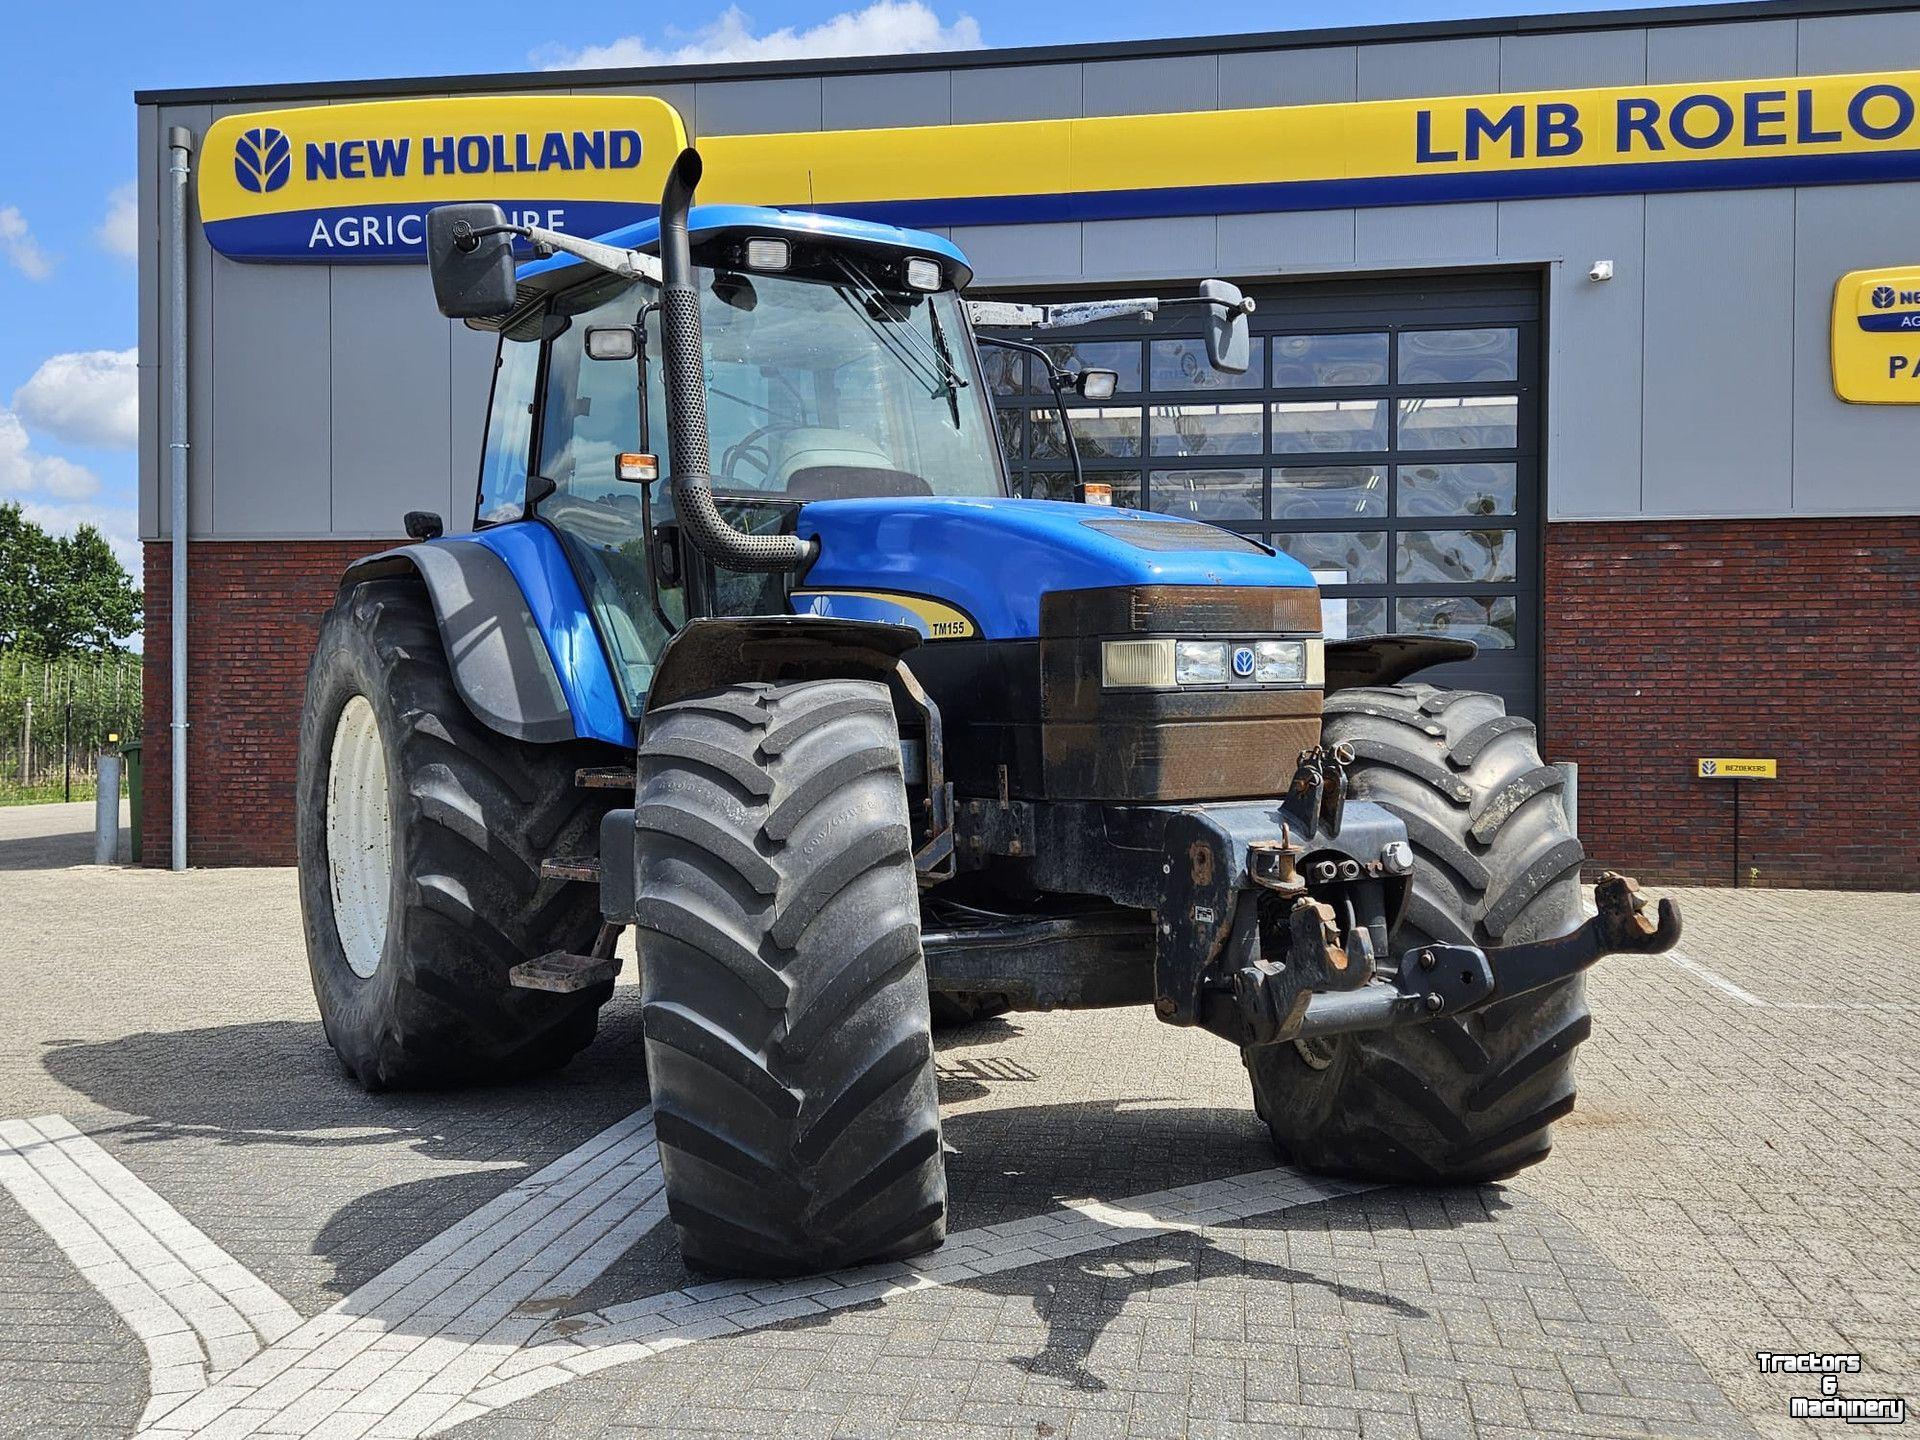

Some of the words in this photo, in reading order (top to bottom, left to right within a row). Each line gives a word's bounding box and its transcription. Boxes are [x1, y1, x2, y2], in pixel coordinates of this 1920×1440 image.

[1416, 103, 1584, 163] LMB
[1616, 84, 1915, 152] ROELO
[305, 138, 410, 180] NEW
[423, 130, 643, 176] HOLLAND
[308, 209, 566, 249] AGRICRE
[933, 622, 965, 635] TM155
